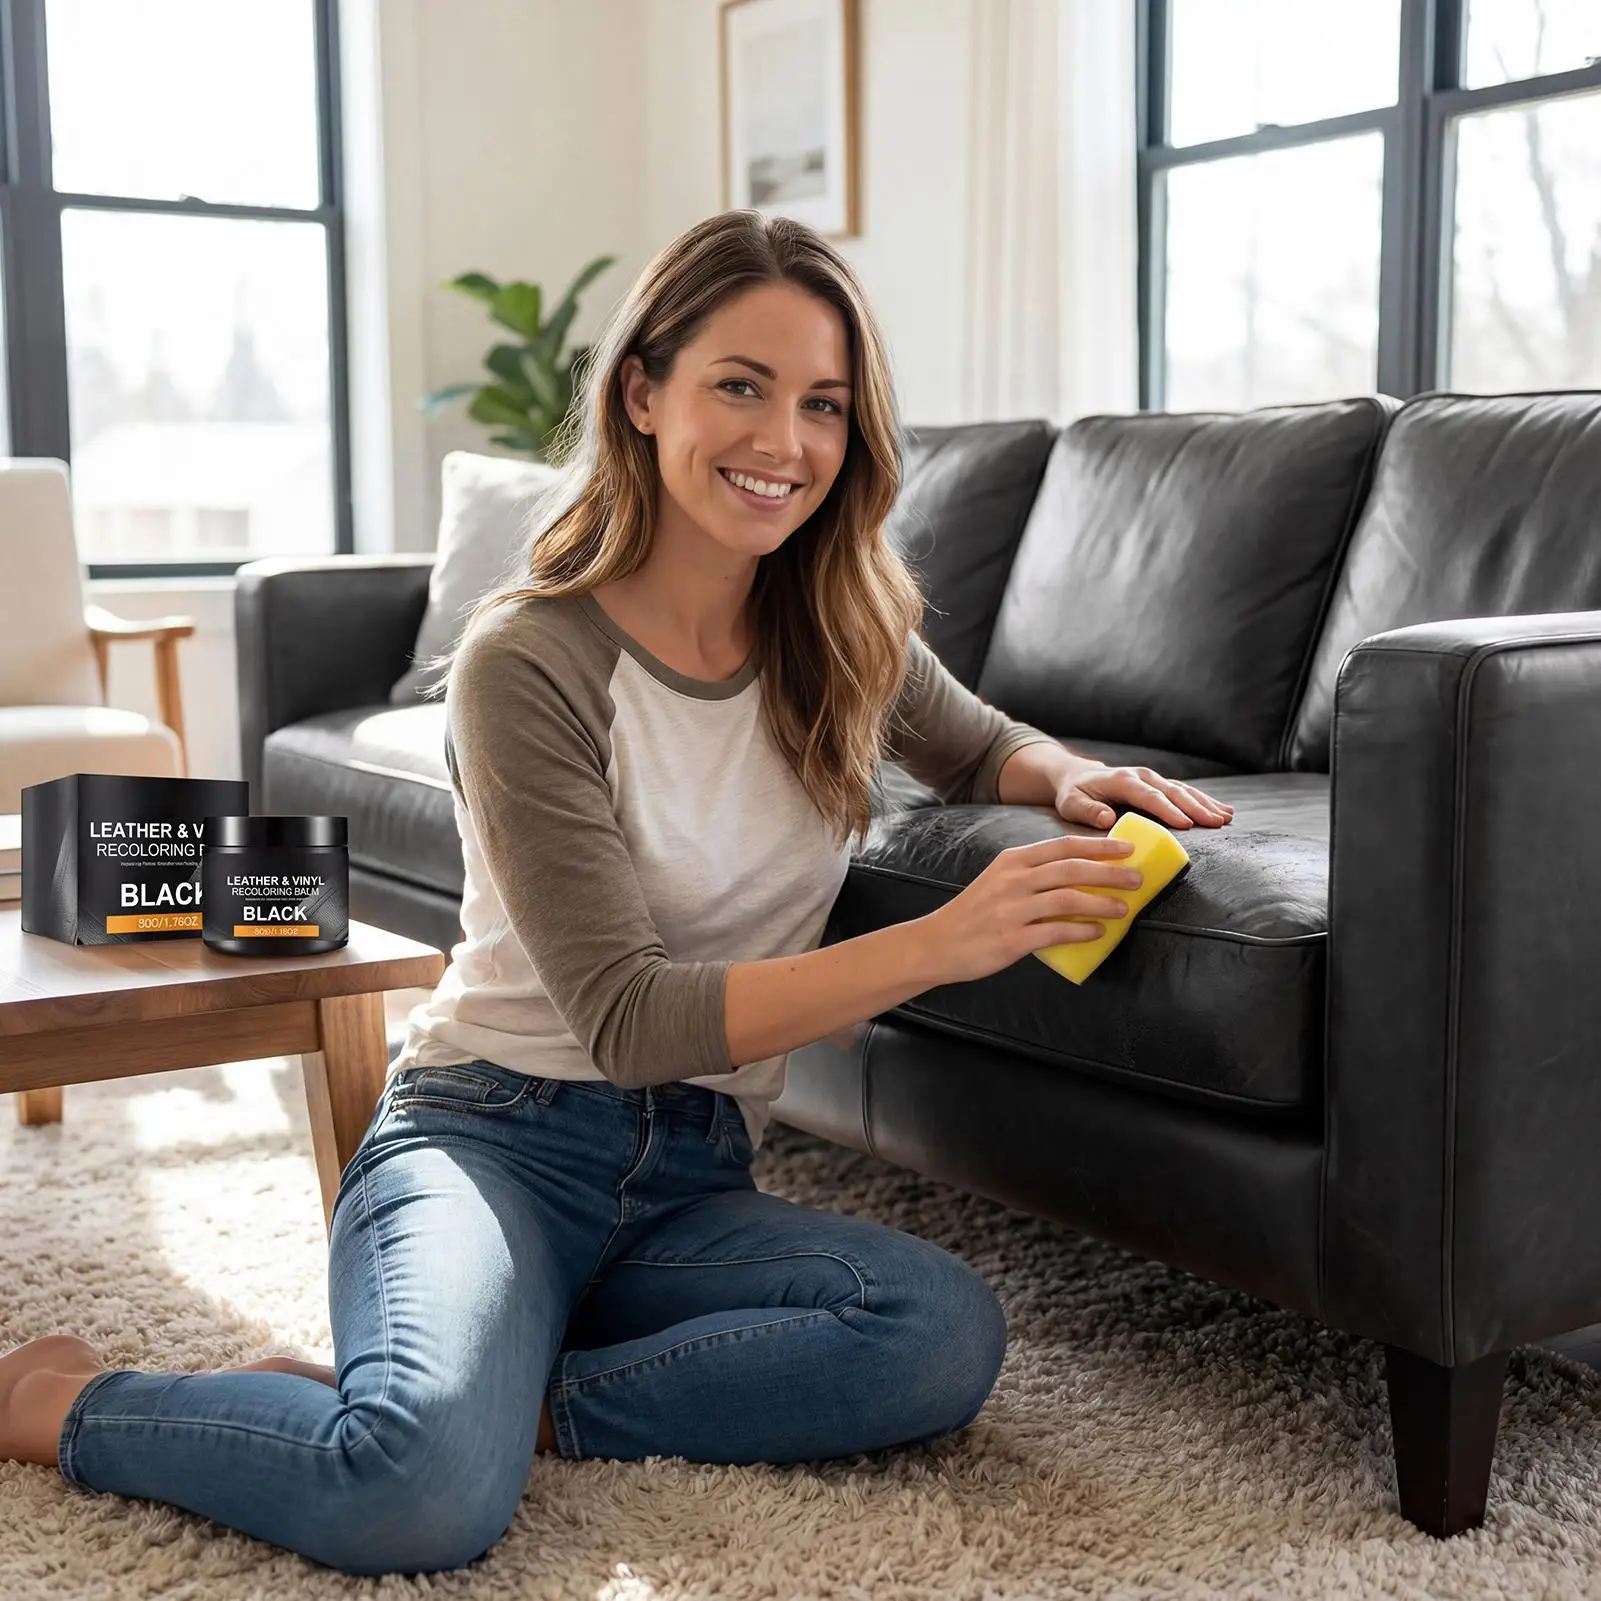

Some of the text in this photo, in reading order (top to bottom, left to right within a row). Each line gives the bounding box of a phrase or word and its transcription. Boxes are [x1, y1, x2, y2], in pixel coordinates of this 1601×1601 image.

[90, 822, 172, 838] LEATHER
[177, 823, 189, 839] &
[96, 843, 195, 857] RECOLORING
[227, 876, 325, 886] LEATHER & VINYL
[231, 887, 320, 896] RECOLORING BALM
[243, 906, 307, 921] BLACK
